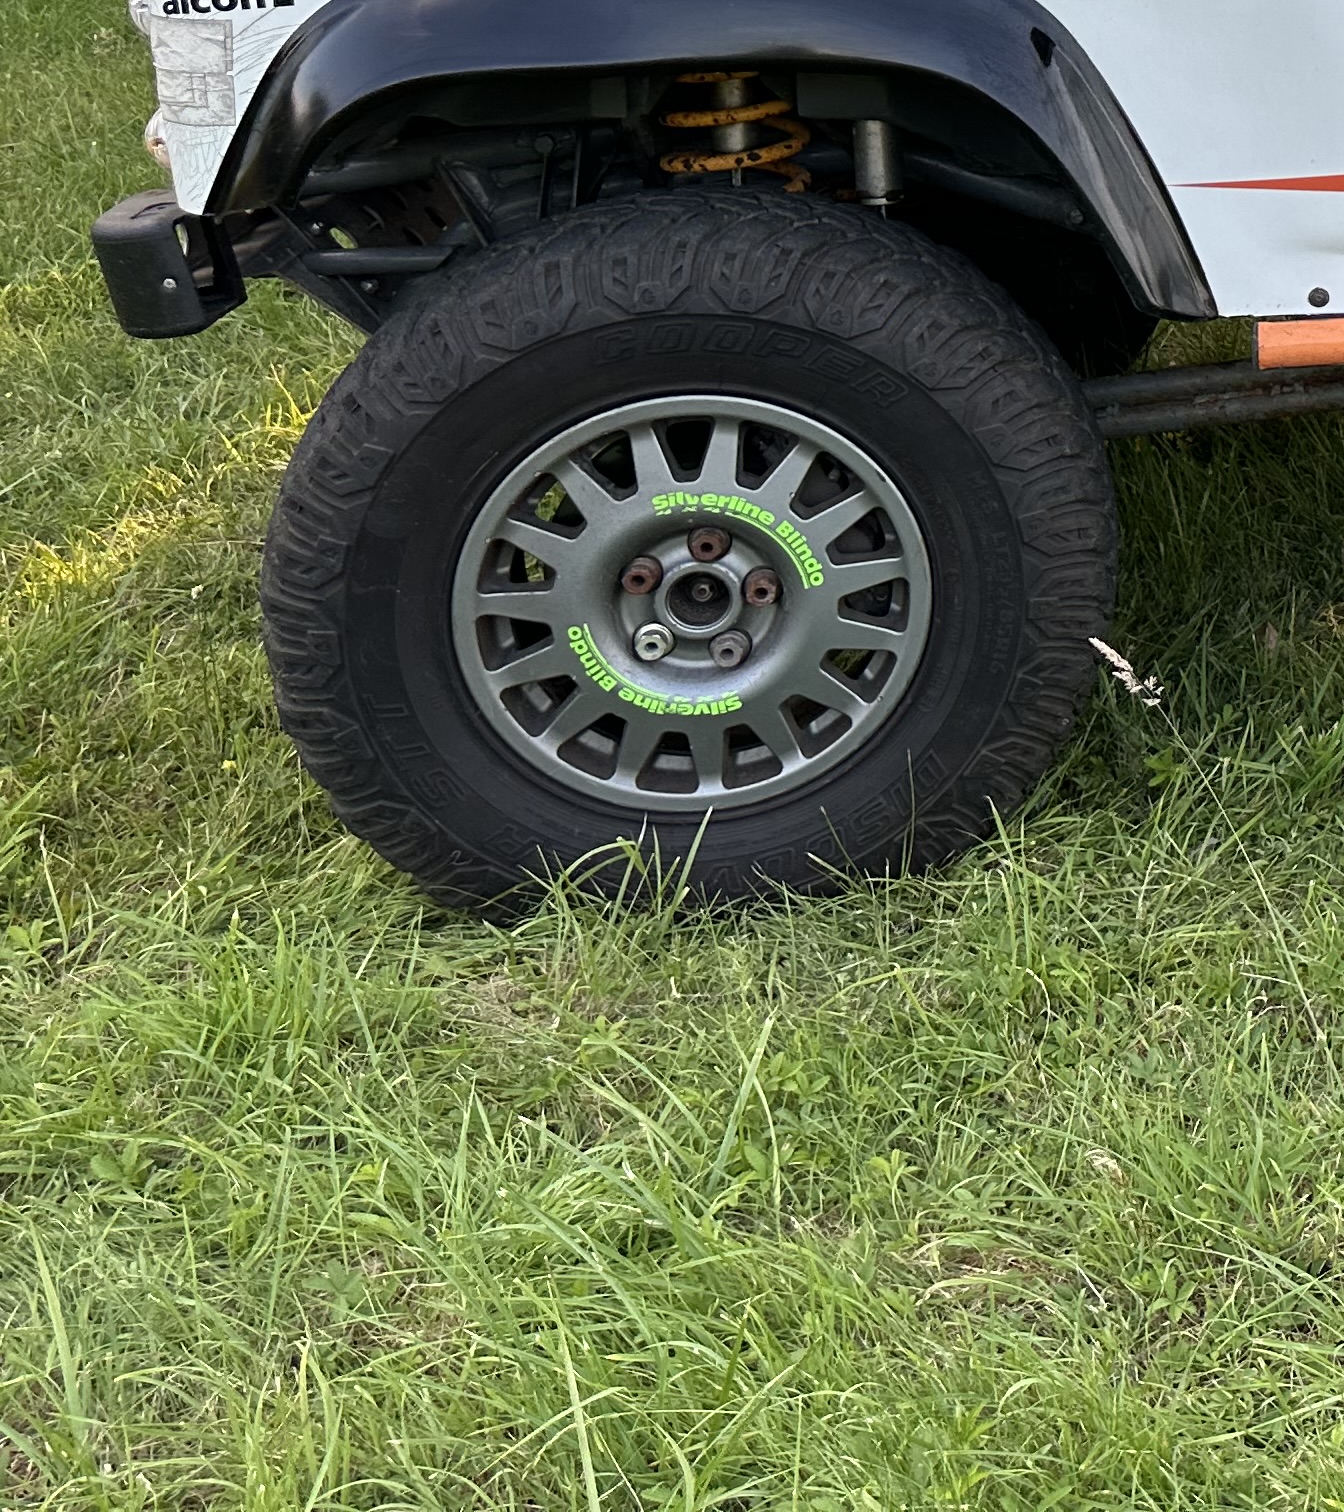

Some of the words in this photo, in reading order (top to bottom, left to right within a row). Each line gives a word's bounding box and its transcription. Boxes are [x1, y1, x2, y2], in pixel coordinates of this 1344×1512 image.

[592, 322, 910, 408] COOPER
[651, 491, 776, 526] Silverline
[775, 520, 825, 586] Blindo
[567, 626, 618, 692] Blindo
[617, 687, 743, 716] Silverline
